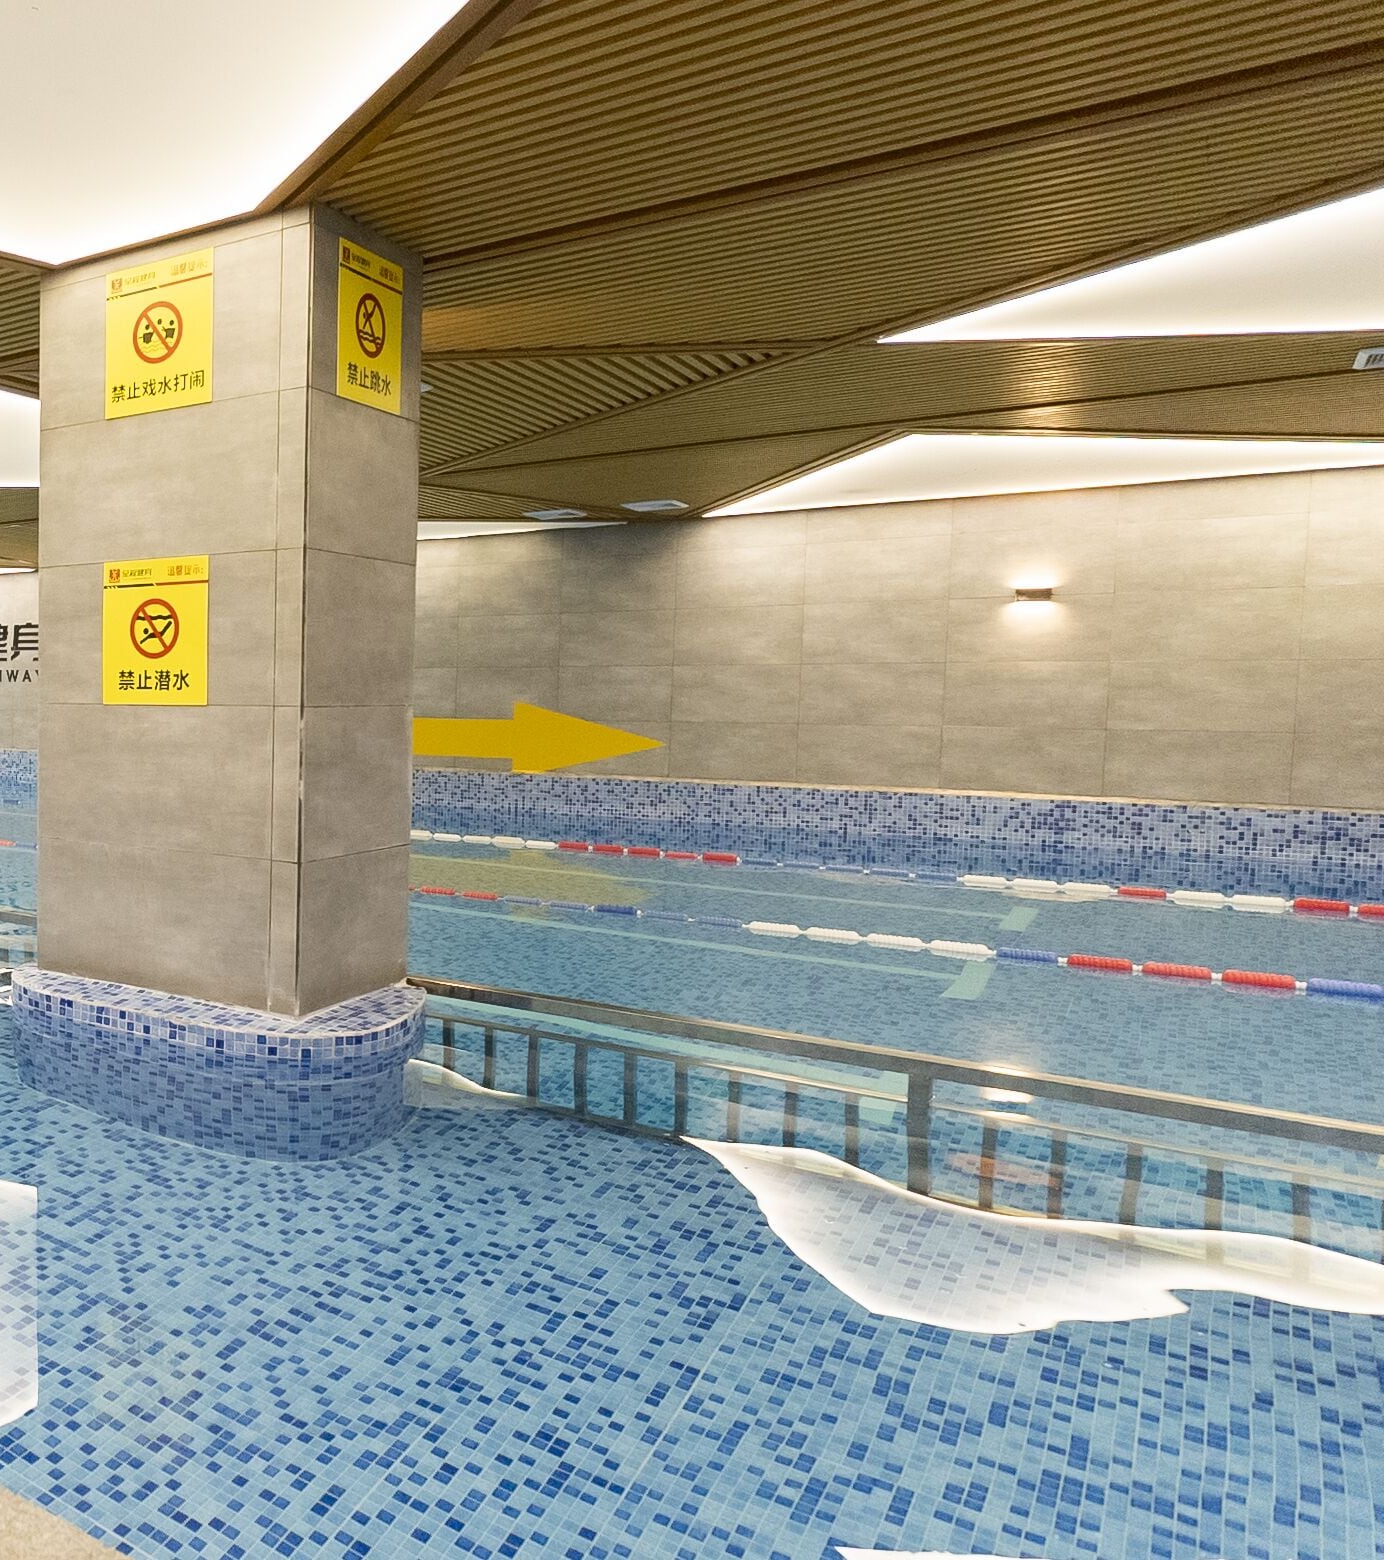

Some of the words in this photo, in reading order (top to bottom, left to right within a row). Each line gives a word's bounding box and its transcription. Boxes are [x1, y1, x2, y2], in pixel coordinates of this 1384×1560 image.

[111, 369, 205, 403] 禁止戏水打闹
[347, 361, 392, 396] 禁止跳水
[118, 669, 189, 691] 禁止潜水
